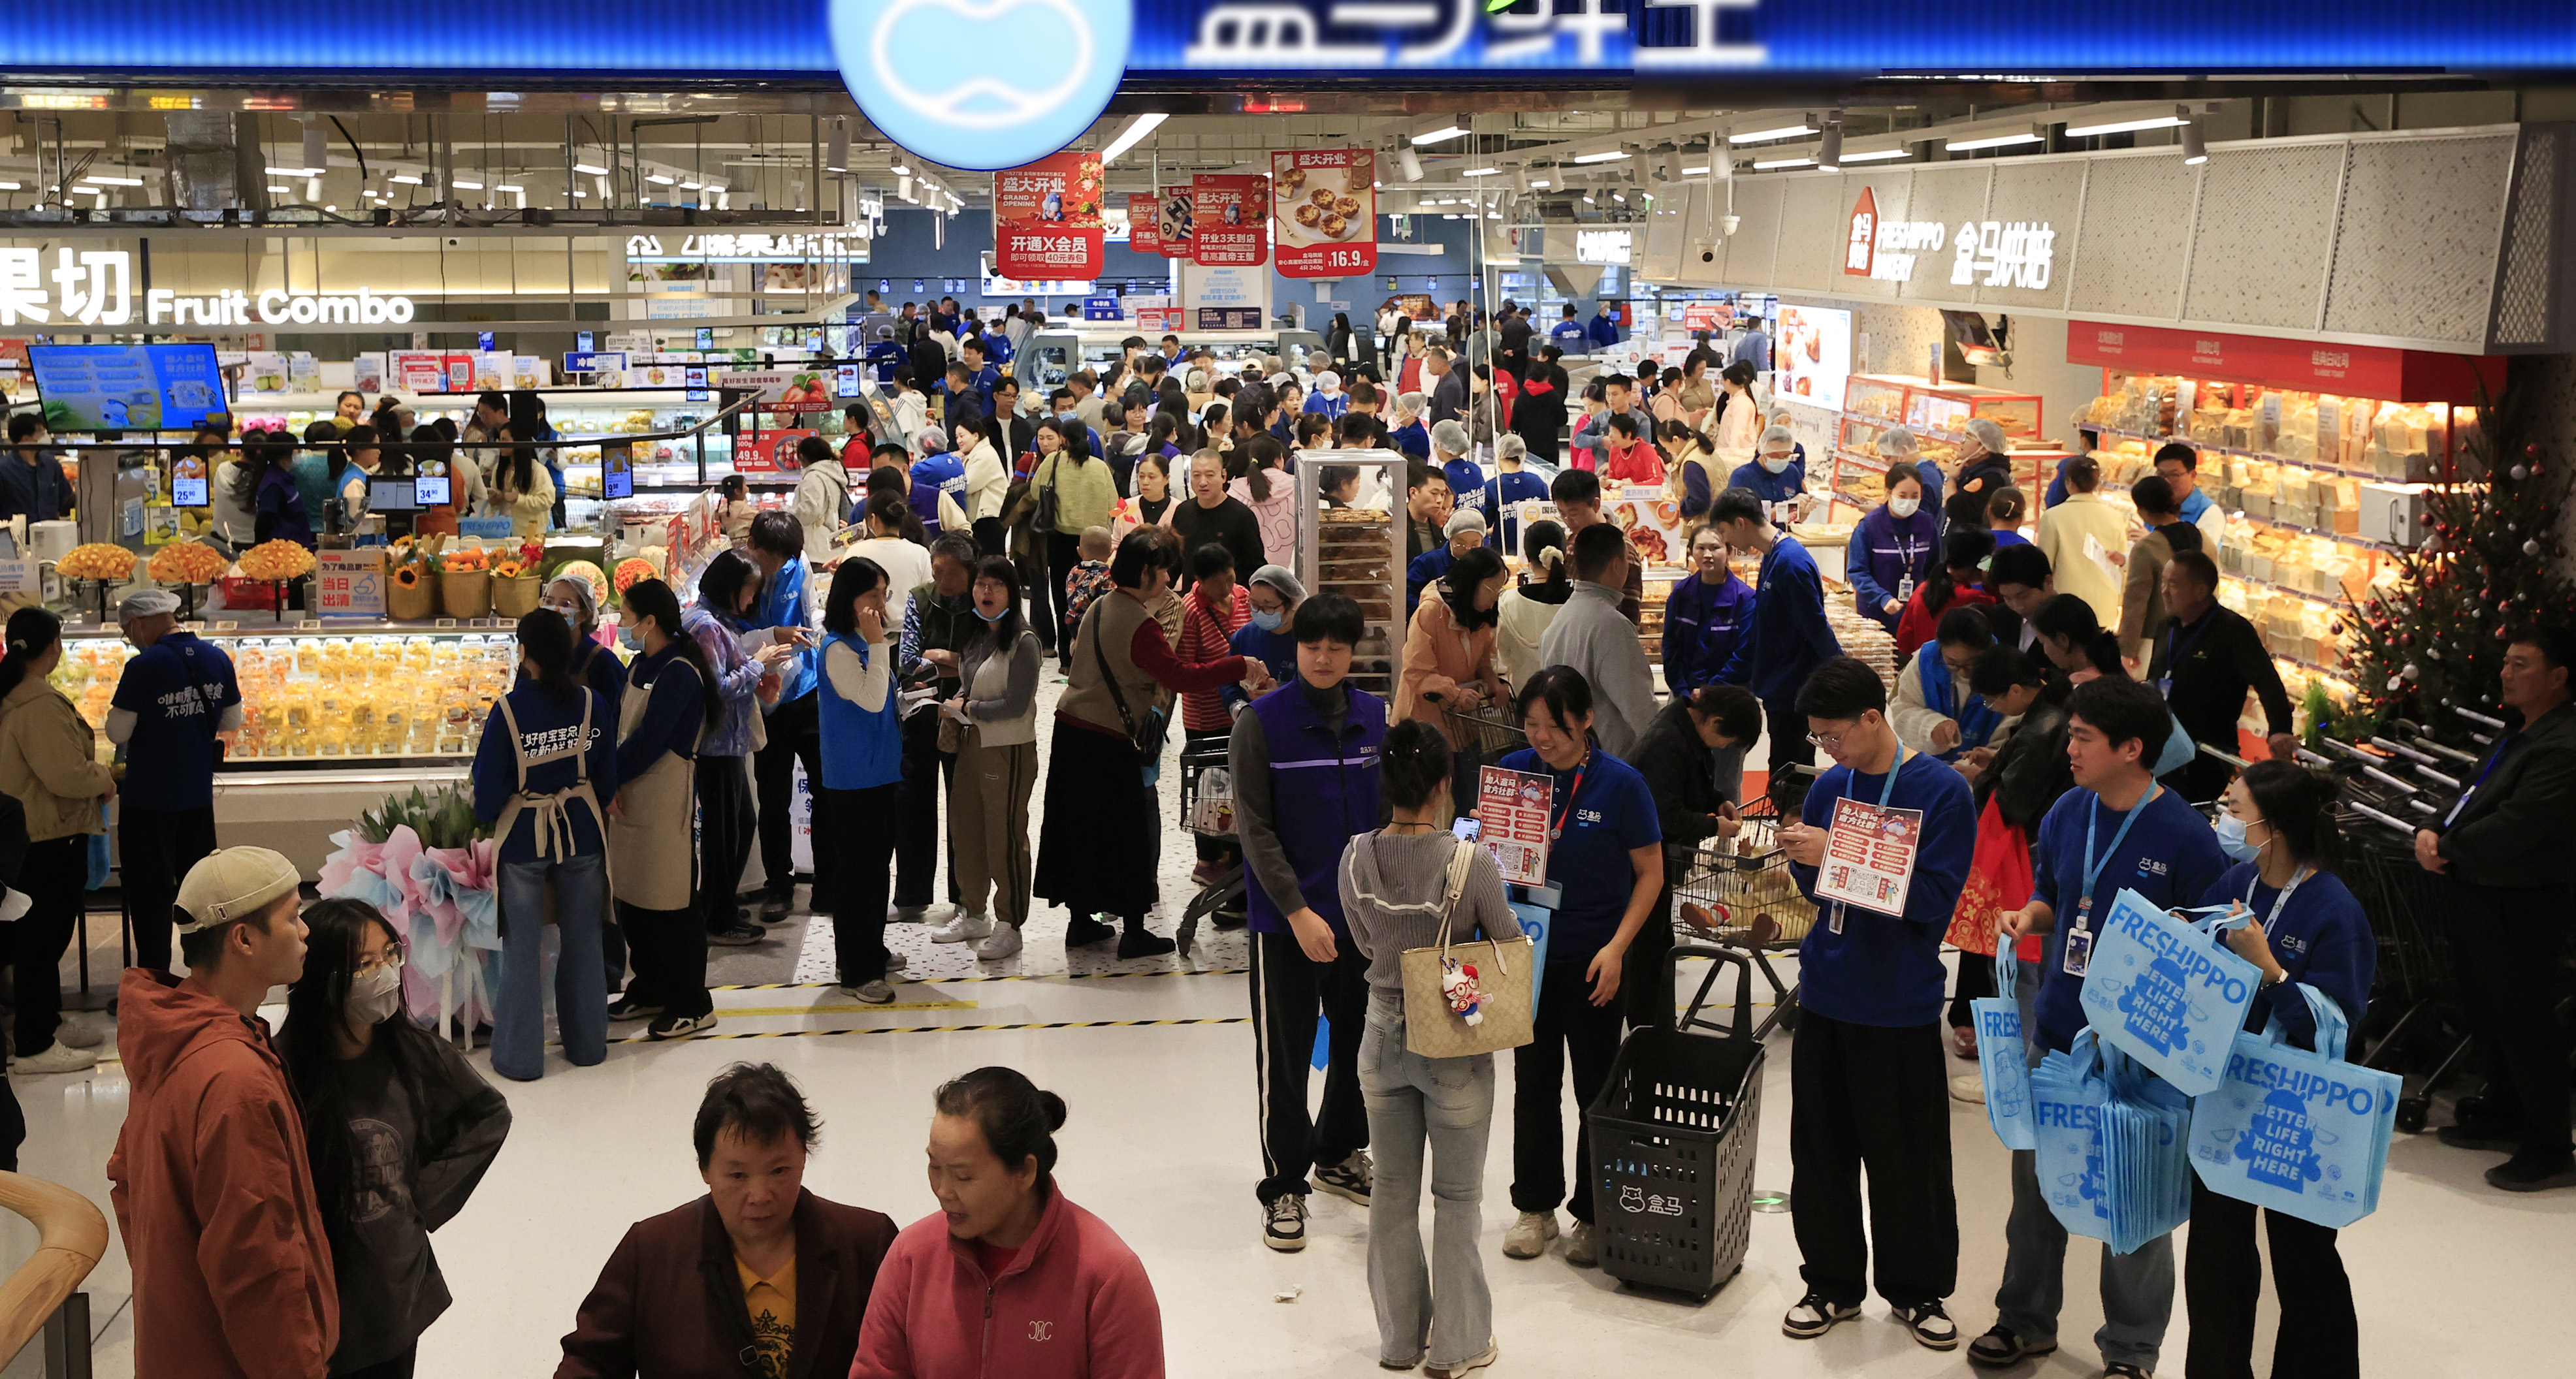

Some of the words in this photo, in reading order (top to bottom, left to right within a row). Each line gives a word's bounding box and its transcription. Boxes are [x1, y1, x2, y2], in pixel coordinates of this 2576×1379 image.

[1299, 153, 1346, 165] 盛大开业
[1003, 177, 1066, 193] 盛大开业
[1197, 193, 1242, 204] 盛大开业
[1010, 236, 1087, 253] 开通X会员
[1200, 234, 1256, 244] 开业3天到店
[1010, 253, 1044, 262] 即可领取
[1047, 253, 1084, 262] 40元券包
[1200, 252, 1255, 262] 最高赢帝王蟹
[1950, 221, 2055, 290] 盒马烘焙
[0, 247, 131, 325] 果切
[148, 288, 248, 325] Fruit
[258, 287, 415, 325] Combo
[177, 491, 188, 501] 25
[420, 490, 431, 499] 34
[323, 577, 349, 591] 当日
[323, 594, 349, 607] 出清
[1483, 784, 1516, 797] 官方社群
[1838, 814, 1878, 830] 官方社群
[2108, 902, 2247, 1004] FRESHIPPO
[2143, 964, 2194, 1006] BETTER
[2146, 984, 2176, 1013] LIFE
[2132, 994, 2179, 1032] RIGHT
[2129, 1011, 2170, 1045] HERE
[2225, 1053, 2374, 1116] RESHIPPO
[2253, 1100, 2317, 1132] BETTER
[2264, 1122, 2301, 1145] LIFE
[2252, 1136, 2307, 1165] RIGHT
[2253, 1154, 2300, 1181] HERE
[1647, 1194, 1683, 1216] 盒马
